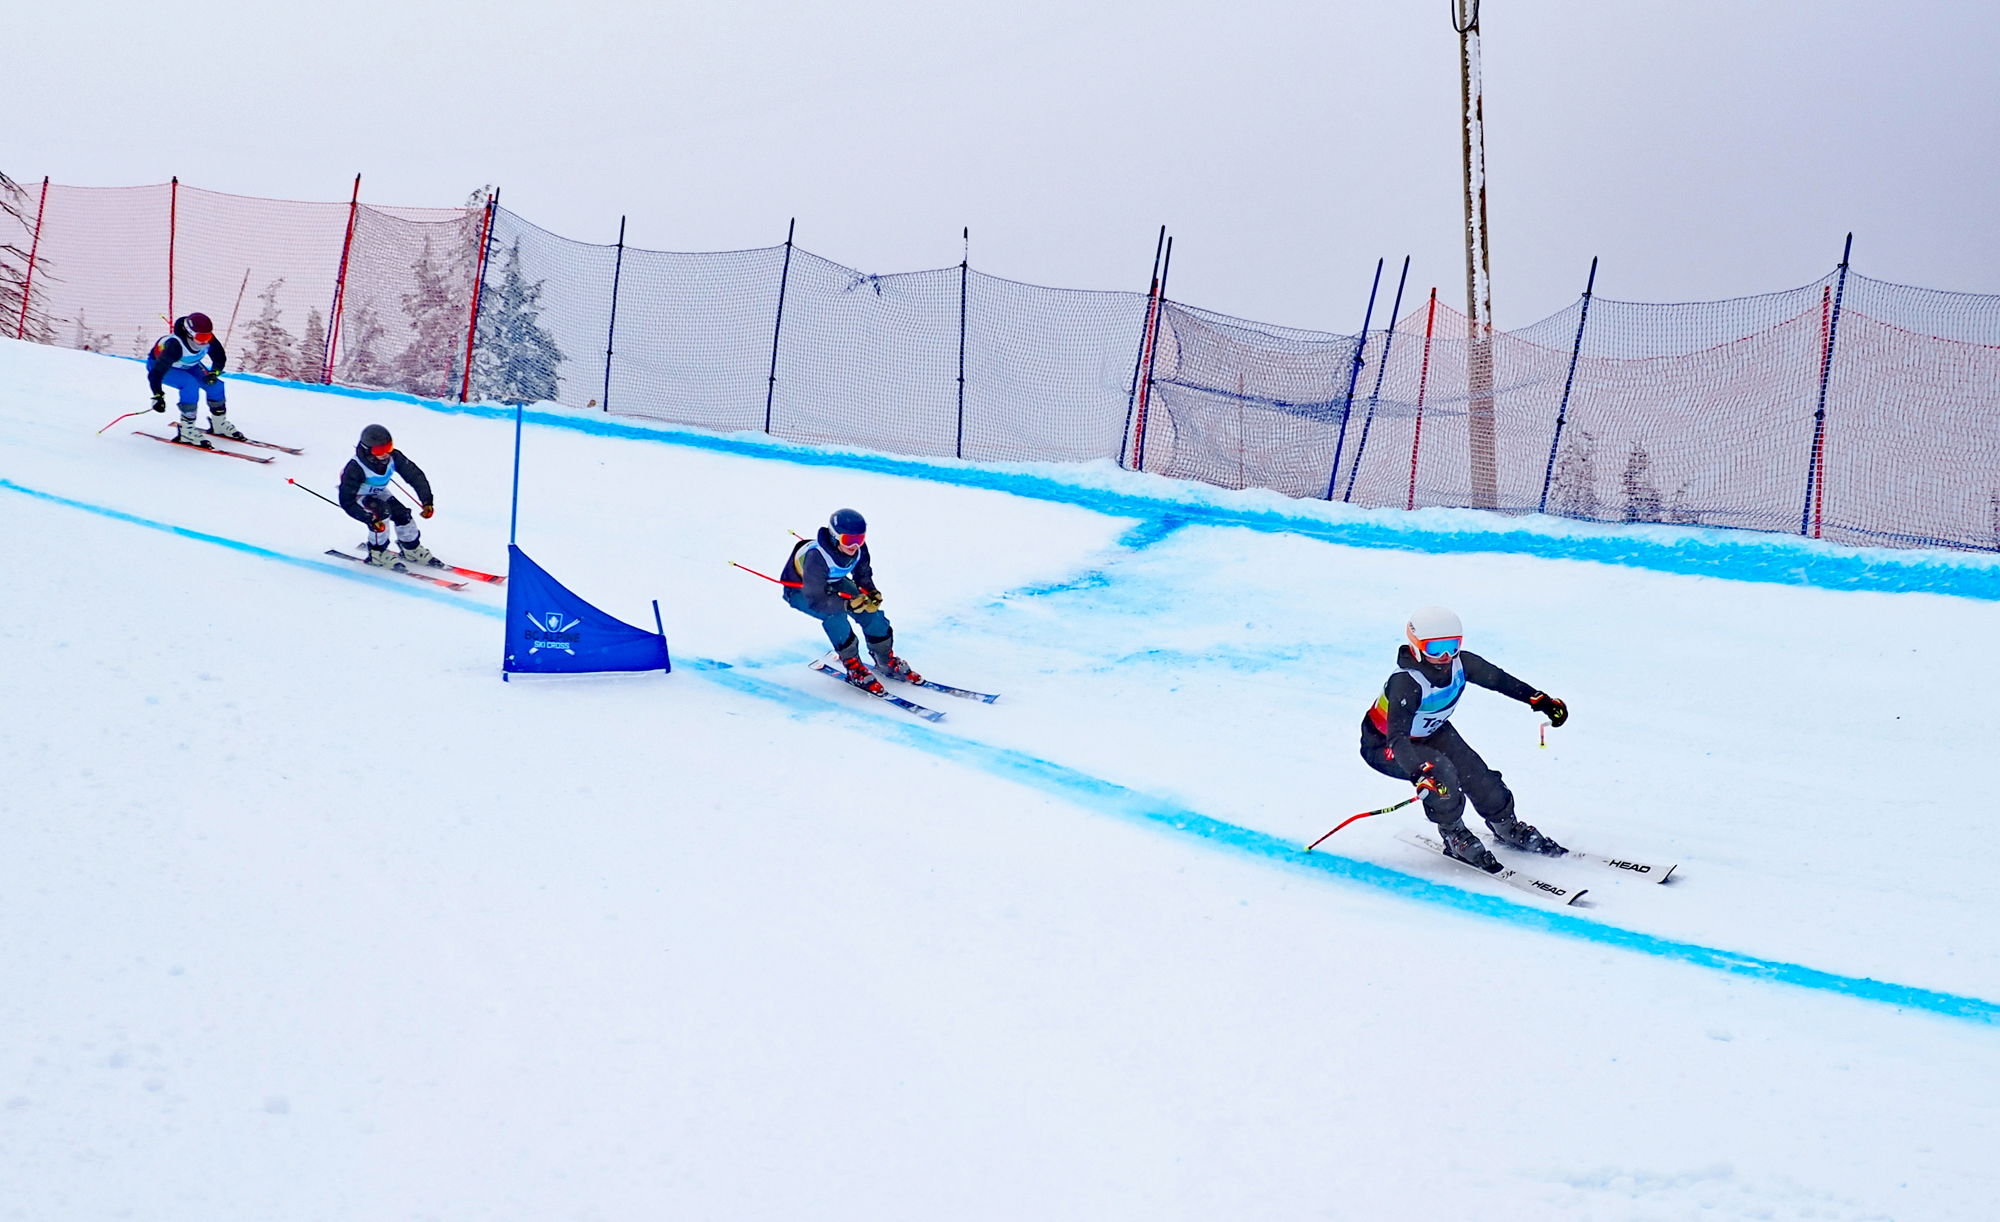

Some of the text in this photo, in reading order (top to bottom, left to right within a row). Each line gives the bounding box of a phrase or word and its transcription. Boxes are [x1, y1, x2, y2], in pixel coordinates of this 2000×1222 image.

[534, 640, 570, 650] SKI CROSS
[1608, 859, 1651, 873] HEAD
[1531, 880, 1566, 896] HEAD
